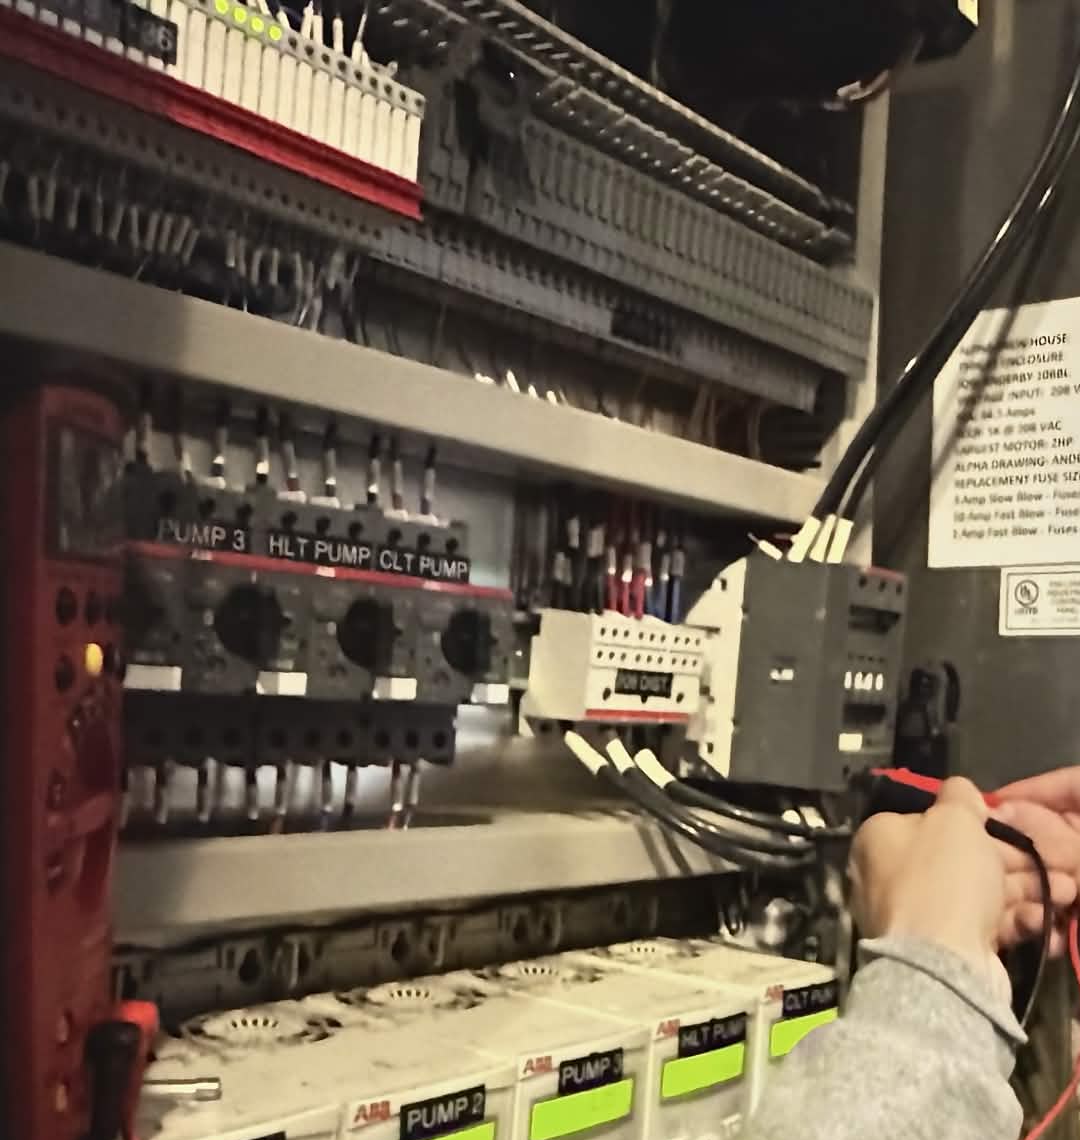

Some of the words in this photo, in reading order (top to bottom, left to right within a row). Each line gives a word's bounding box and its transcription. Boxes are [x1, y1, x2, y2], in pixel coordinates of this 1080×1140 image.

[1051, 437, 1073, 448] 2HP
[954, 474, 1029, 489] REPLACEMENT
[1033, 473, 1058, 483] FUSE
[157, 519, 227, 548] PUMP
[231, 528, 247, 551] 3
[1048, 523, 1078, 535] Fuses
[267, 534, 309, 558] HLT
[315, 540, 372, 565] PUMP
[379, 549, 414, 572] CLT
[419, 555, 468, 580] PUMP
[562, 1058, 612, 1087] PUMP
[406, 1100, 468, 1133] PUMP
[470, 1091, 485, 1116] 2
